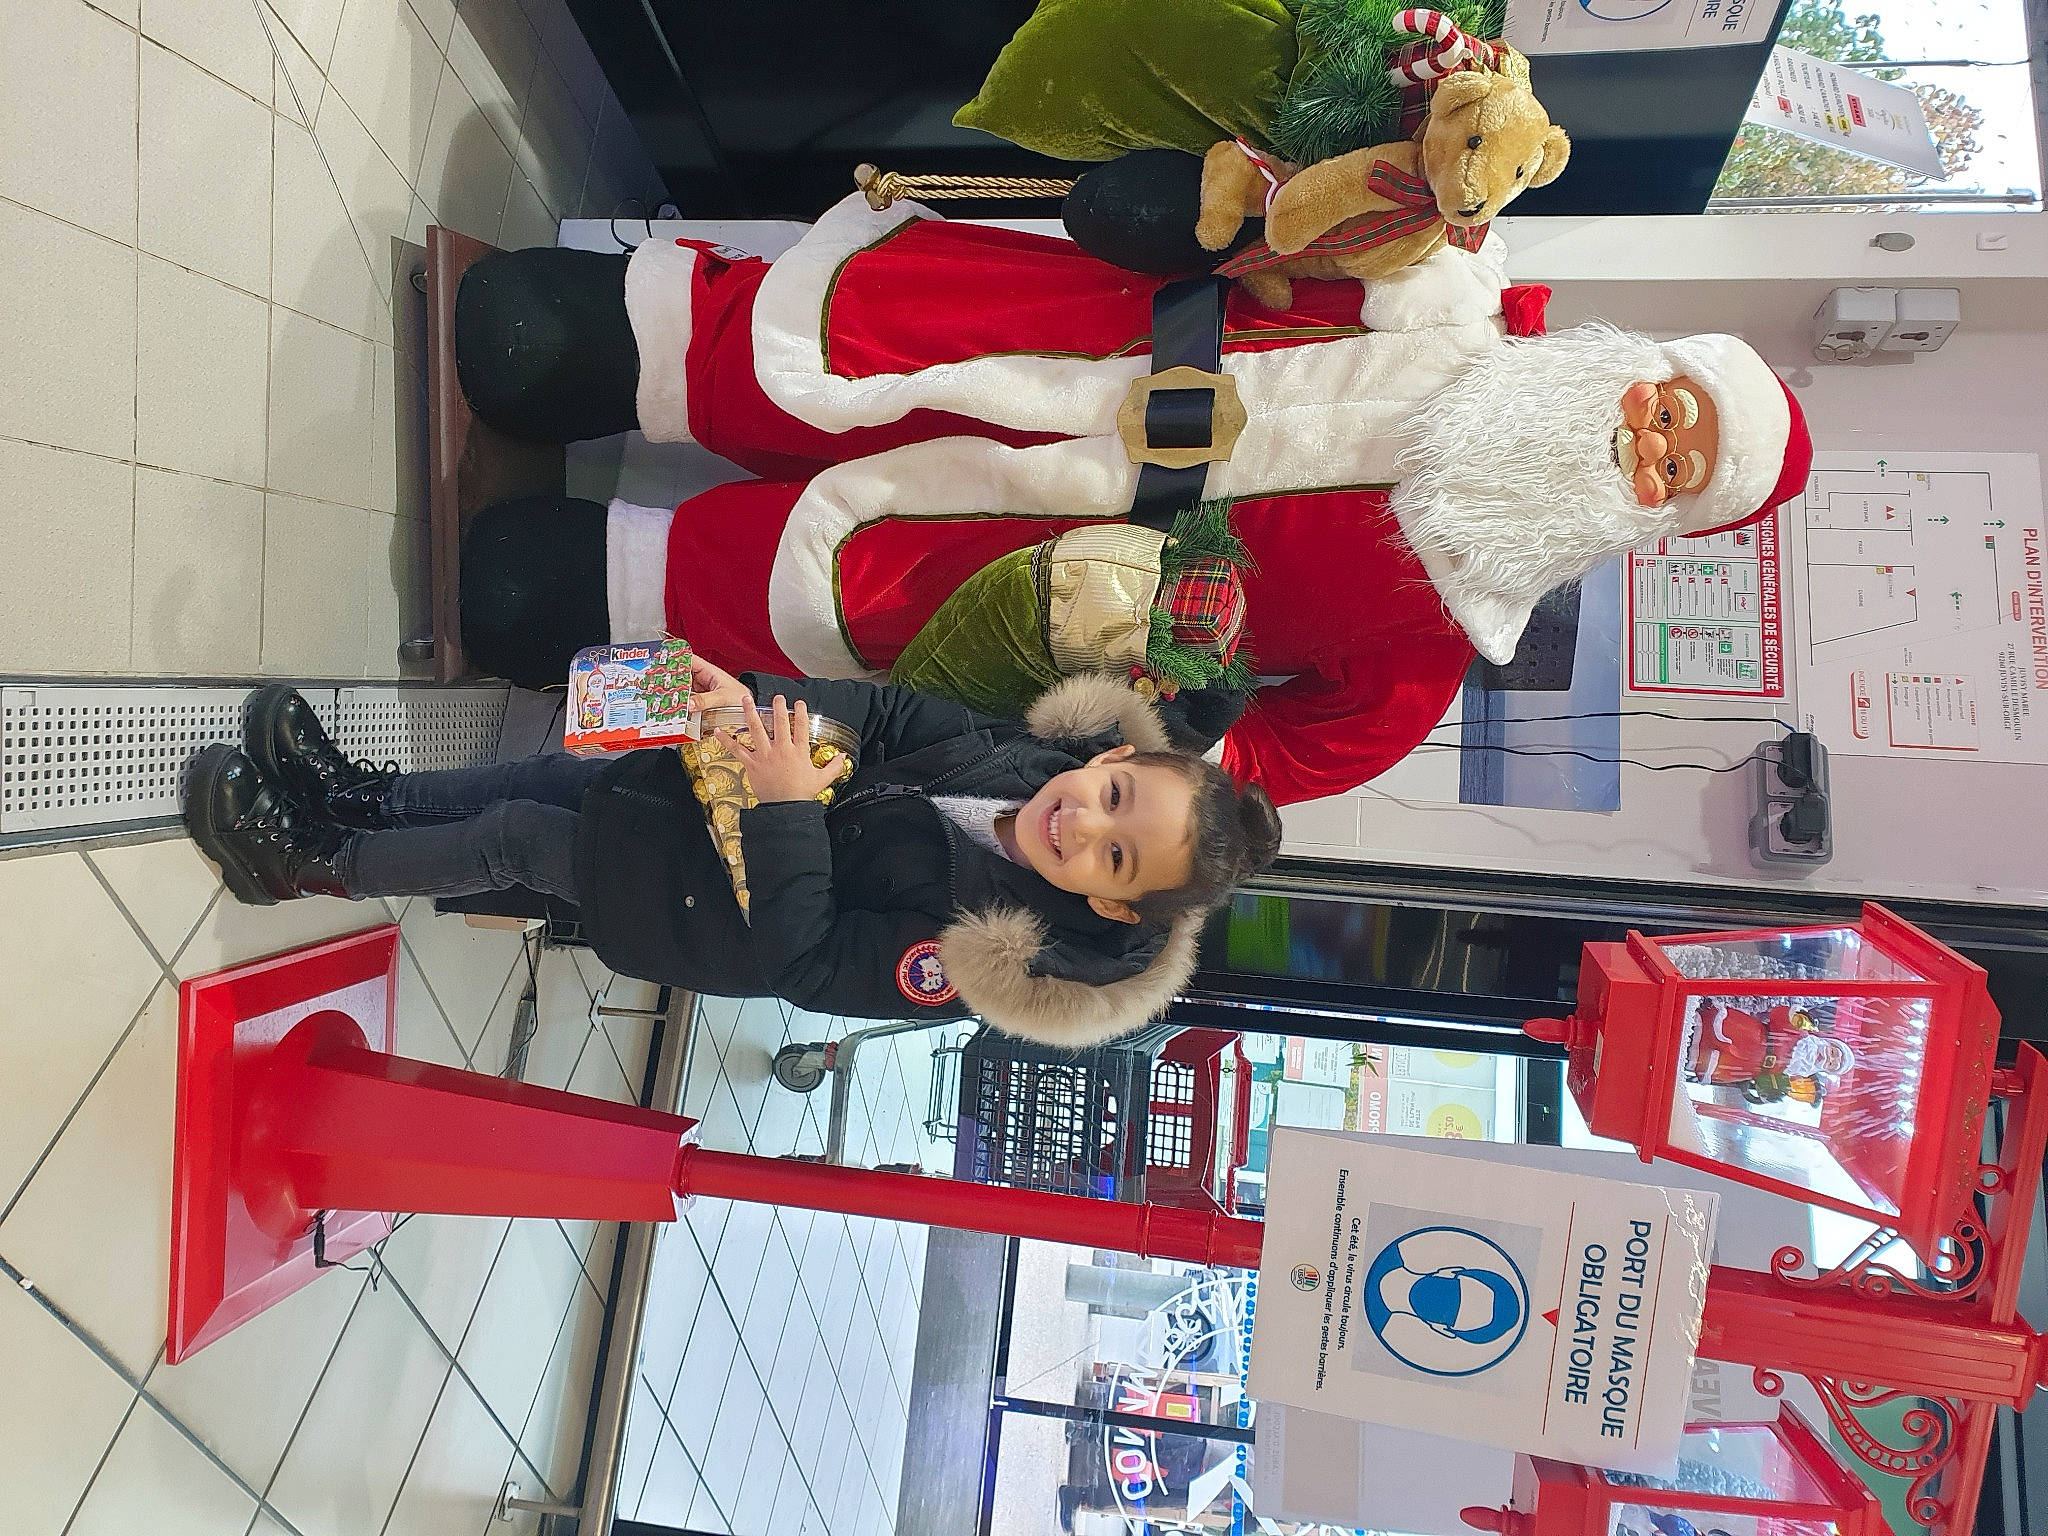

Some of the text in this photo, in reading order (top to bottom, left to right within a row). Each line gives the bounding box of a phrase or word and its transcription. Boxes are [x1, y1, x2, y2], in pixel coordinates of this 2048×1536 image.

[1761, 513, 1782, 691] NSIGNES GÉNÉRALES DE SÉCURITÉ
[2008, 652, 2016, 664] RUE
[2009, 666, 2018, 696] CAMILLE
[2018, 667, 2028, 691] JUVISY
[2023, 528, 2048, 690] PLAN D'INTERVENTION
[1315, 1169, 1348, 1391] Ensemble continuons d'appliquer les gestes barrières.
[1337, 1218, 1361, 1351] Cet été, le virus circule toujours.
[1565, 1244, 1607, 1405] OBLIGATOIRE
[1601, 1220, 1651, 1439] PORT DU MASQUE
